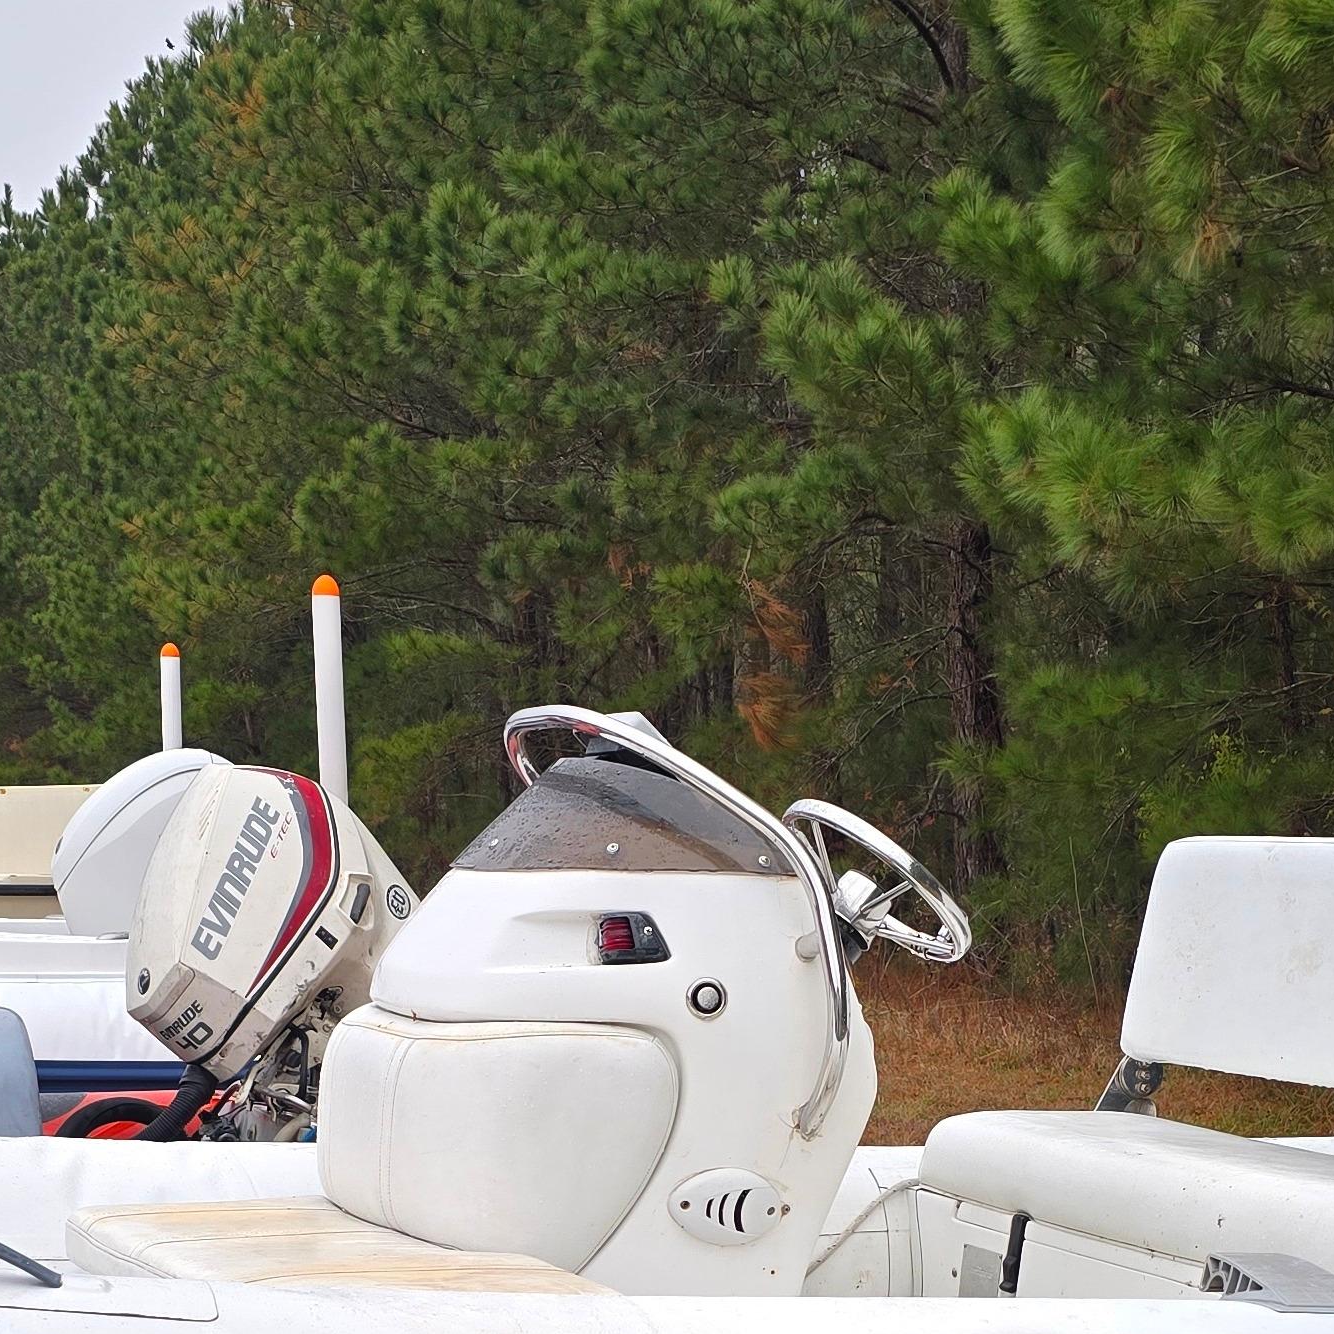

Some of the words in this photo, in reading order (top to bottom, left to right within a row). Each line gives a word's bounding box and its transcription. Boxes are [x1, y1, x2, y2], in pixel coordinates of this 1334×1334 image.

[270, 811, 292, 858] E-TEC
[190, 796, 280, 961] EVINRUDE
[175, 1021, 214, 1050] 40
